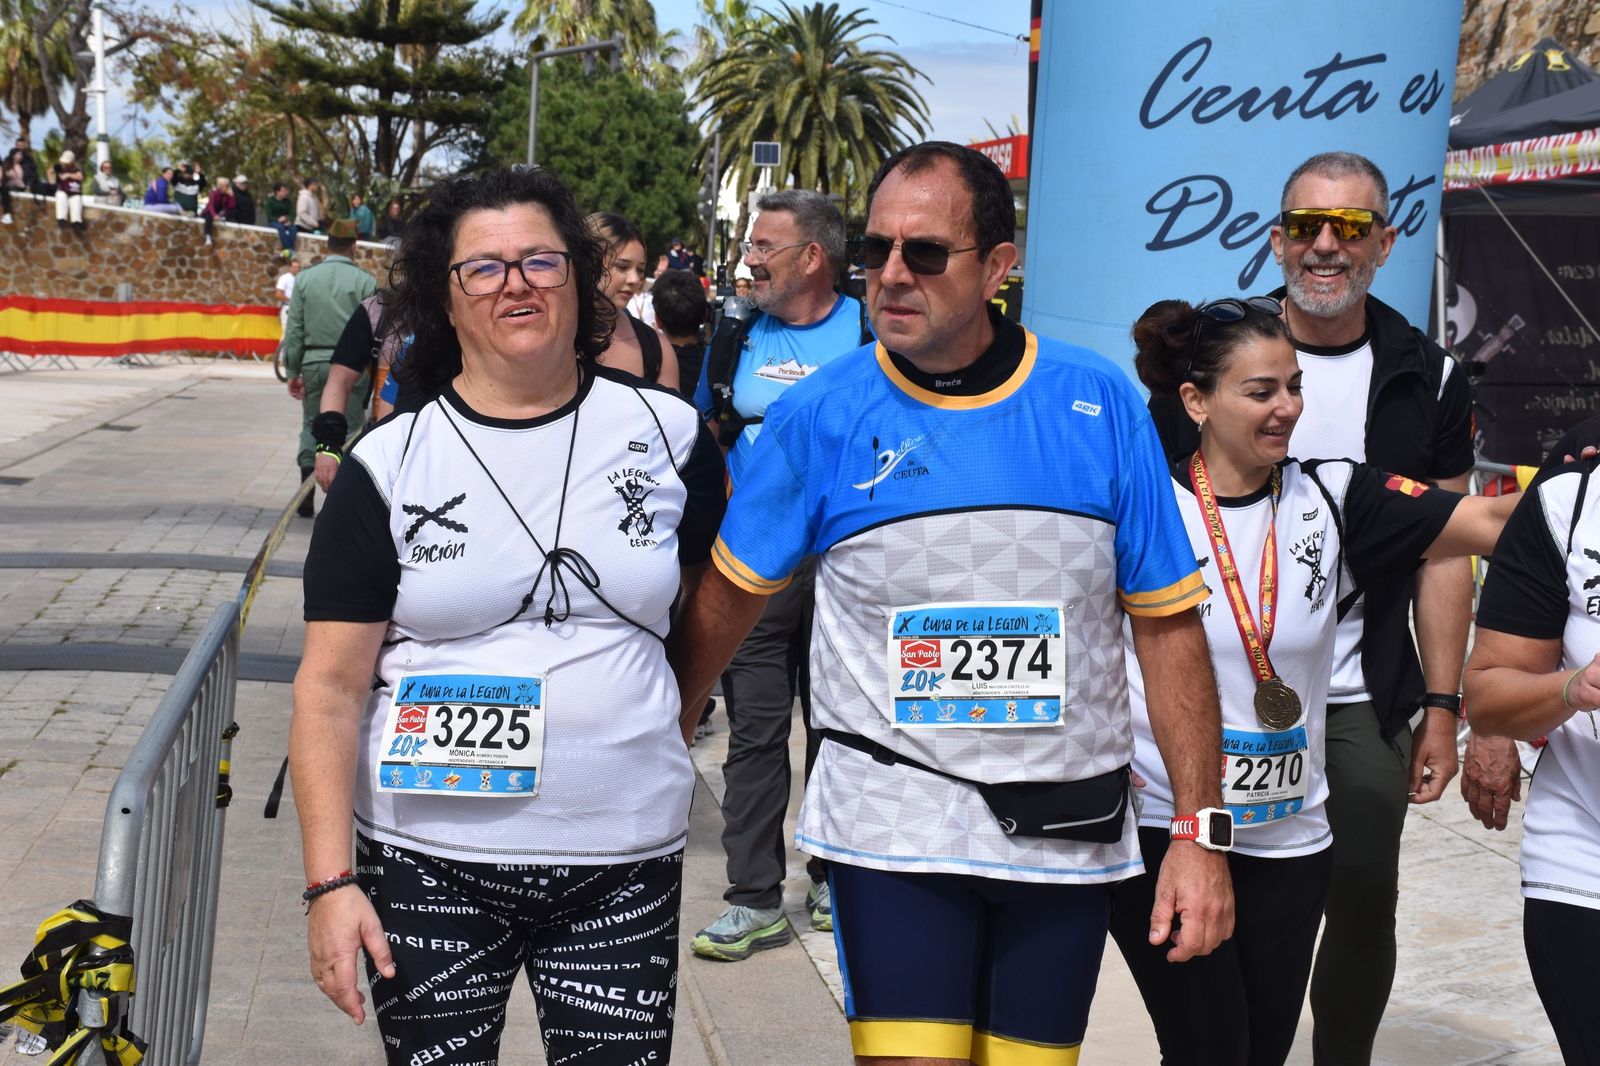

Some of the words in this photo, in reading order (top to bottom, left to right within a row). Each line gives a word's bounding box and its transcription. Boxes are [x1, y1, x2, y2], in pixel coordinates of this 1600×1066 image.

[1399, 69, 1445, 115] es
[1145, 174, 1435, 291] Depte
[893, 466, 930, 481] CEUTA
[901, 649, 918, 659] San
[918, 649, 940, 659] Pablo
[950, 639, 1053, 681] 2374
[900, 669, 946, 692] 20K
[971, 682, 989, 690] LUIS
[397, 715, 410, 724] San
[410, 715, 427, 724] Pablo
[433, 705, 531, 751] 3225
[388, 734, 428, 757] 20K
[1231, 752, 1304, 791] 2210
[650, 955, 670, 968] stay
